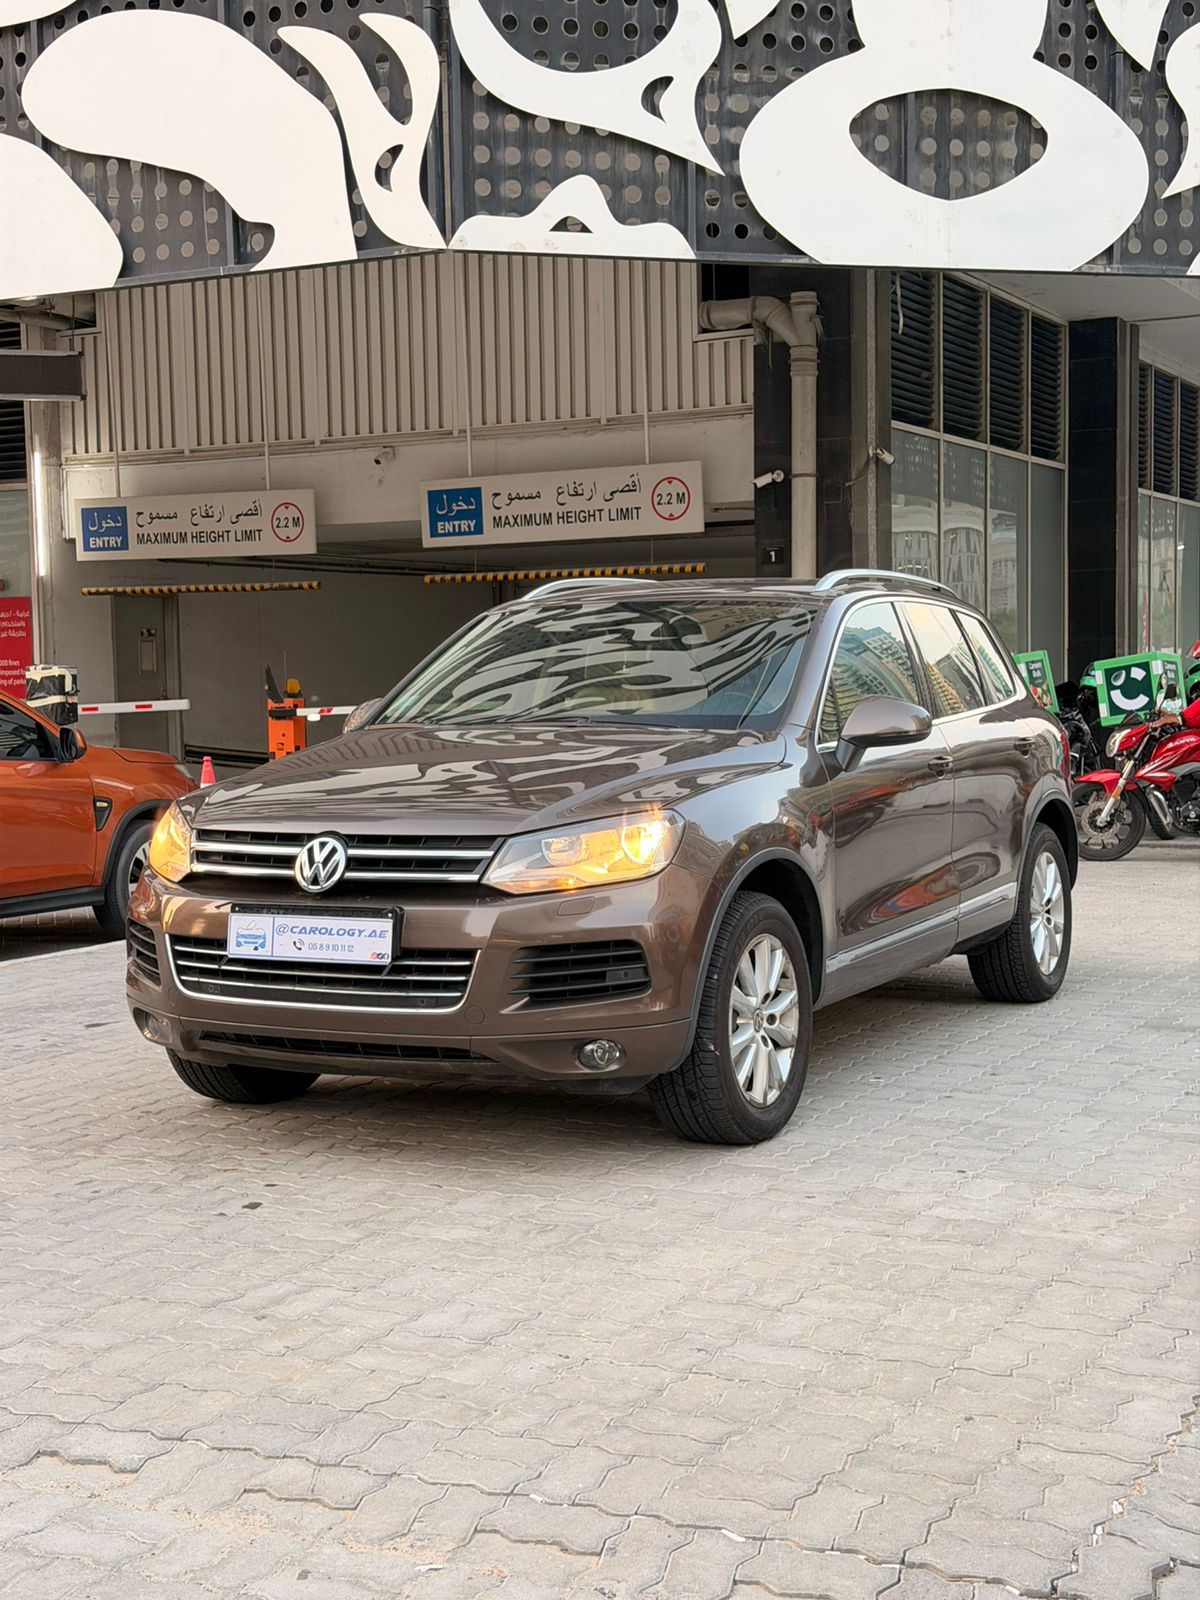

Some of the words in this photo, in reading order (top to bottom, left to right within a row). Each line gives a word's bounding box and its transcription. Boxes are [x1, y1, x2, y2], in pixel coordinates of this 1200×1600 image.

[491, 490, 541, 509] مسموح
[555, 481, 597, 505] ارتفاع
[656, 492, 673, 506] 2.2
[676, 491, 686, 504] M
[436, 493, 476, 516] دخول
[88, 512, 122, 532] دخول
[135, 510, 178, 528] مسموح
[190, 505, 225, 526] ارتفاع
[276, 516, 290, 529] 2.2
[292, 516, 301, 528] M
[492, 512, 552, 529] MAXIMUM
[557, 508, 603, 525] HEIGHT
[608, 506, 642, 522] LIMIT
[437, 519, 476, 534] ENTRY
[89, 536, 123, 549] ENTRY
[136, 531, 188, 546] MAXIMUM
[191, 529, 231, 544] HEIGHT
[234, 528, 263, 542] LIMIT
[769, 551, 776, 562] 1
[276, 923, 389, 939] @CAROLOGY.AE
